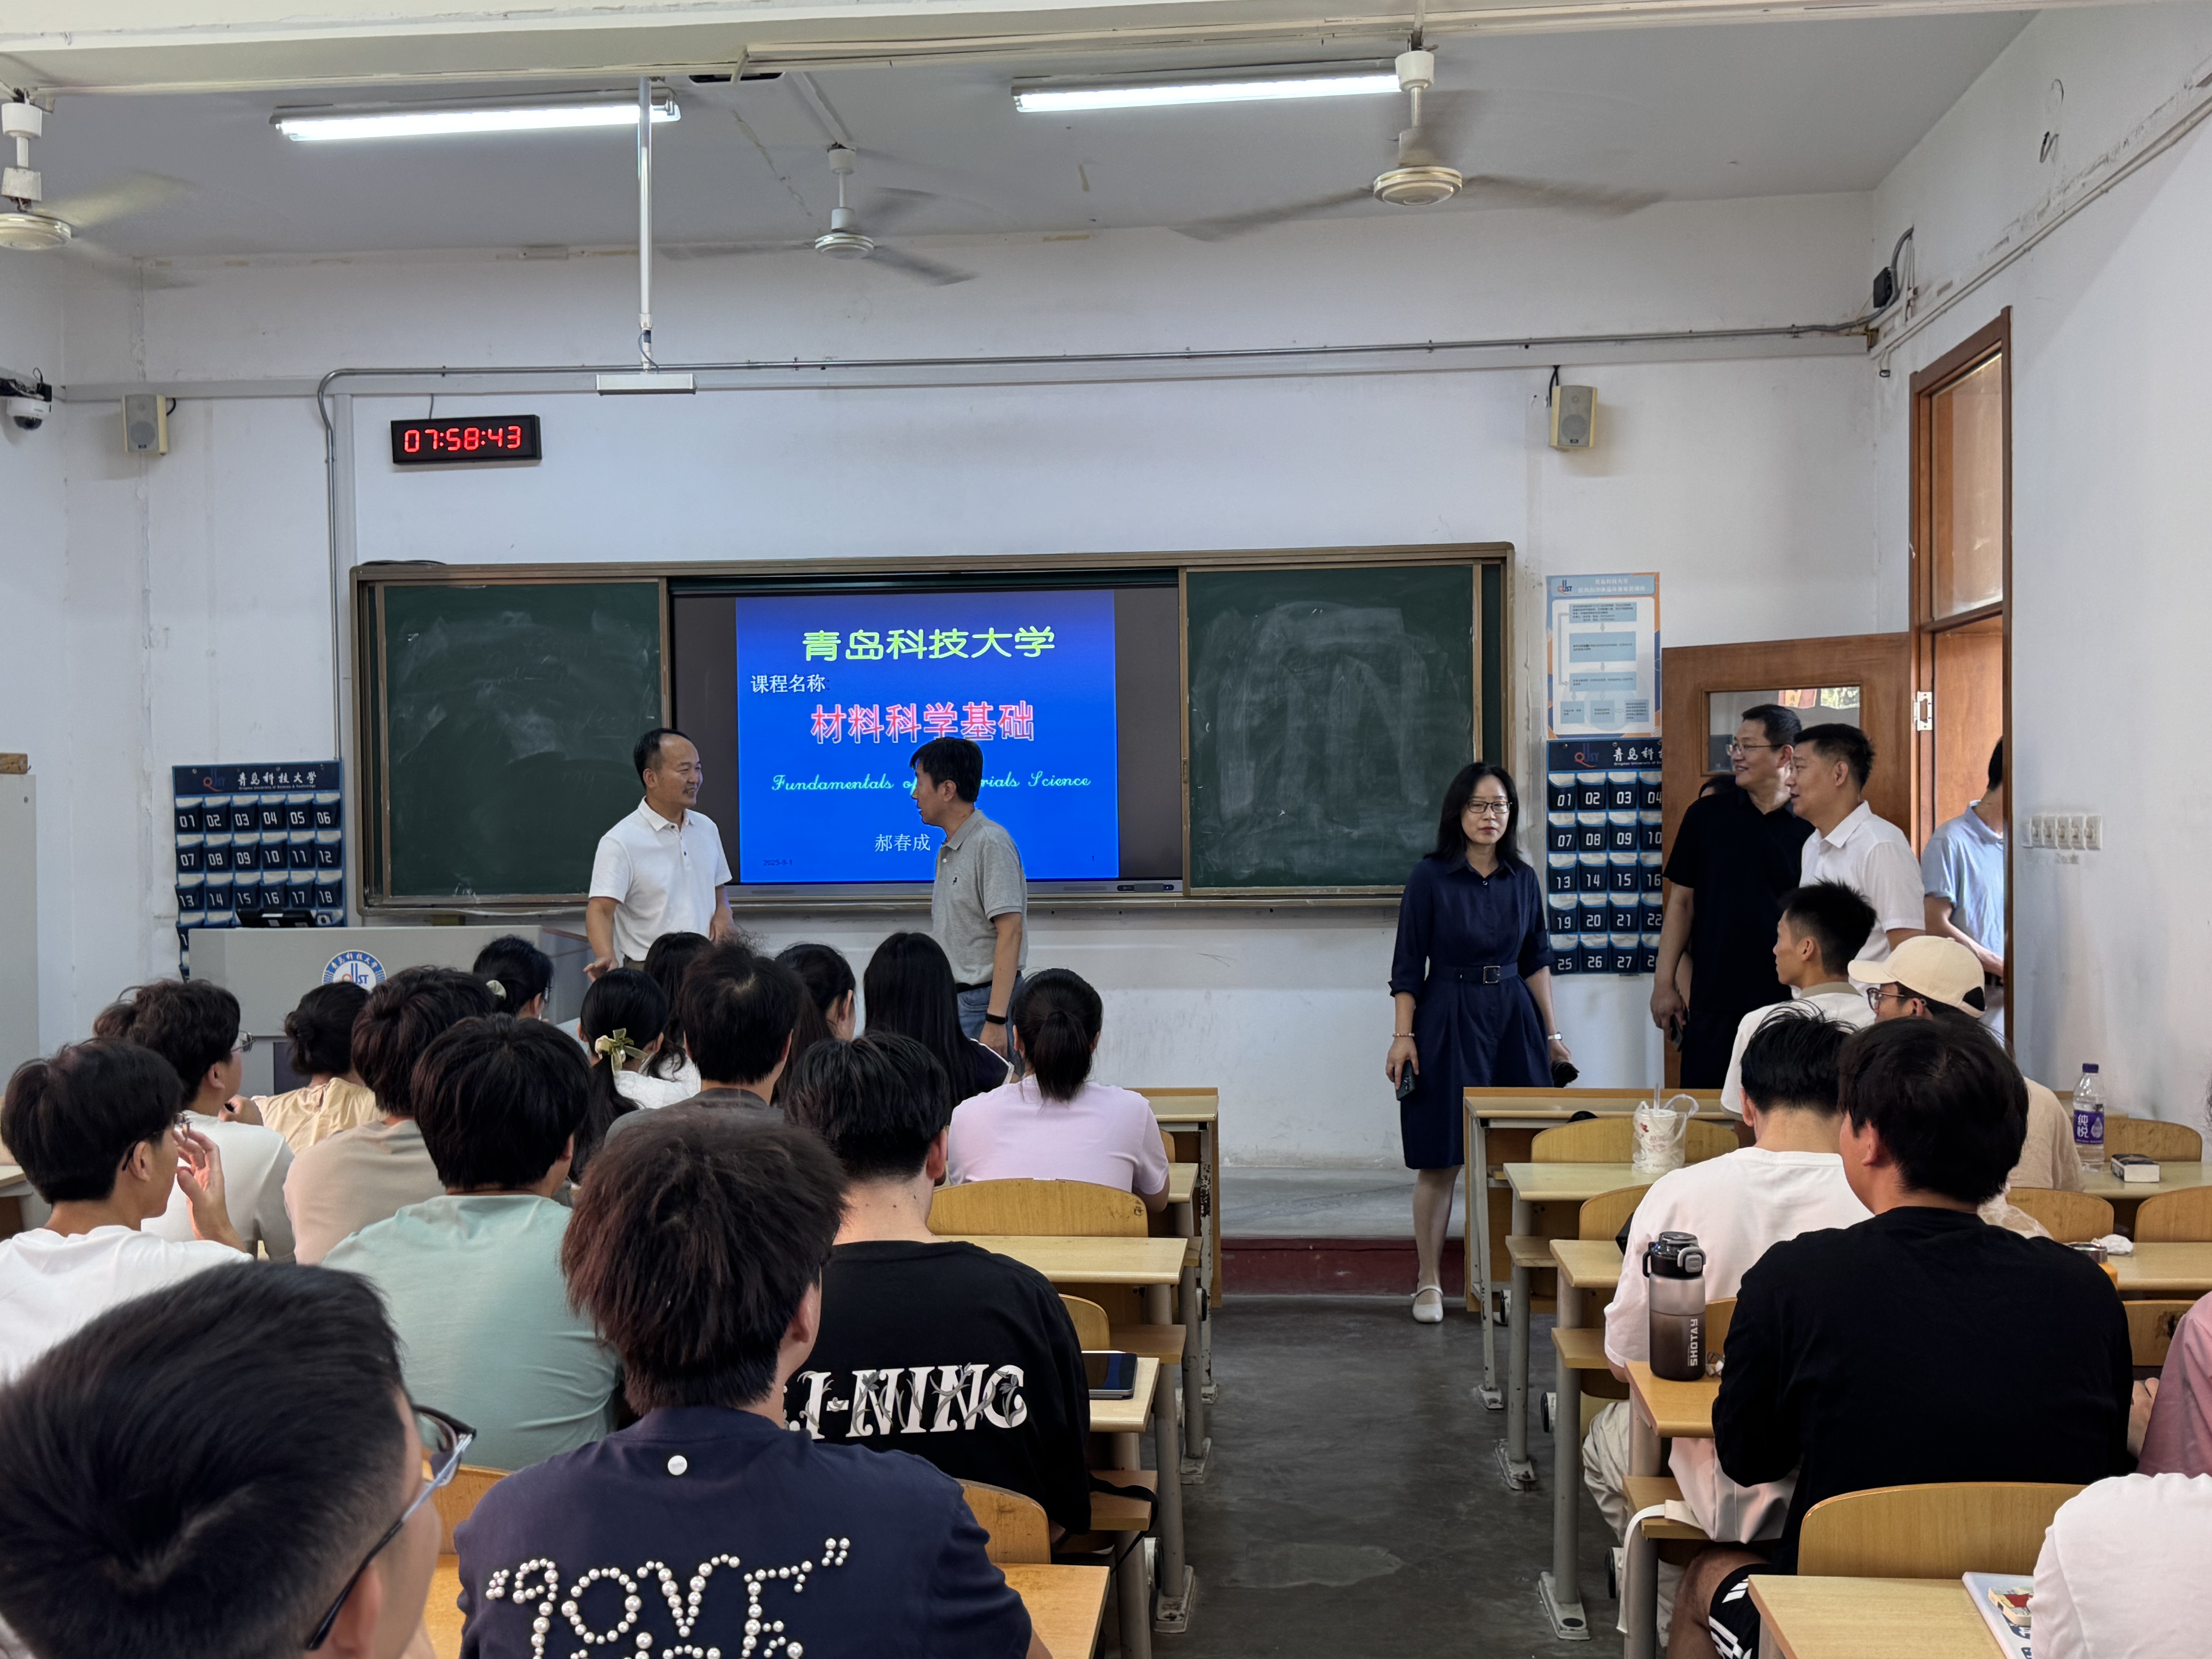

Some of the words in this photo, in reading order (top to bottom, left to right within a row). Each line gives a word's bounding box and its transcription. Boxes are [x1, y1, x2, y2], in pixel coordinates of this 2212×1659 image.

[404, 426, 522, 453] 07:58:43
[803, 626, 1055, 661] 青岛科技大学
[811, 701, 1034, 744] 材料科学基础
[238, 771, 316, 786] 青岛科技大学
[772, 774, 895, 791] Fundamentals
[981, 771, 1020, 787] rials
[1028, 771, 1091, 787] Science
[1557, 793, 1571, 807] 01
[1585, 792, 1600, 805] 02
[1617, 791, 1632, 804] 03
[1647, 792, 1661, 804] 04
[179, 815, 195, 828] 01
[206, 814, 222, 827] 02
[235, 814, 249, 826] 03
[263, 812, 277, 824] 04
[290, 811, 305, 824] 05
[317, 812, 331, 824] 06
[875, 834, 930, 852] 郝春成
[1558, 834, 1572, 847] 07
[1586, 833, 1601, 846] 08
[1617, 832, 1632, 845] 09
[1648, 831, 1662, 844] 10
[180, 853, 194, 866] 07
[208, 853, 223, 866] 08
[236, 852, 251, 864] 09
[265, 850, 280, 863] 10
[292, 850, 306, 863] 11
[319, 850, 332, 863] 12
[1556, 876, 1570, 889] 13
[1587, 874, 1600, 887] 14
[1617, 873, 1631, 886] 15
[1647, 874, 1661, 886] 16
[179, 895, 194, 907] 13
[209, 893, 223, 906] 14
[237, 893, 251, 905] 15
[264, 892, 279, 905] 16
[292, 891, 305, 904] 17
[319, 891, 333, 903] 18
[1557, 916, 1571, 929] 19
[1586, 914, 1601, 927] 20
[1617, 914, 1631, 926] 21
[1647, 913, 1662, 926] 22
[1558, 958, 1572, 970] 25
[1588, 956, 1602, 968] 26
[1617, 956, 1632, 968] 27
[1647, 955, 1657, 967] 2
[2077, 1114, 2089, 1138] 纯悦
[1690, 1319, 1698, 1367] SHOTAY
[783, 1362, 1027, 1440] I-NING
